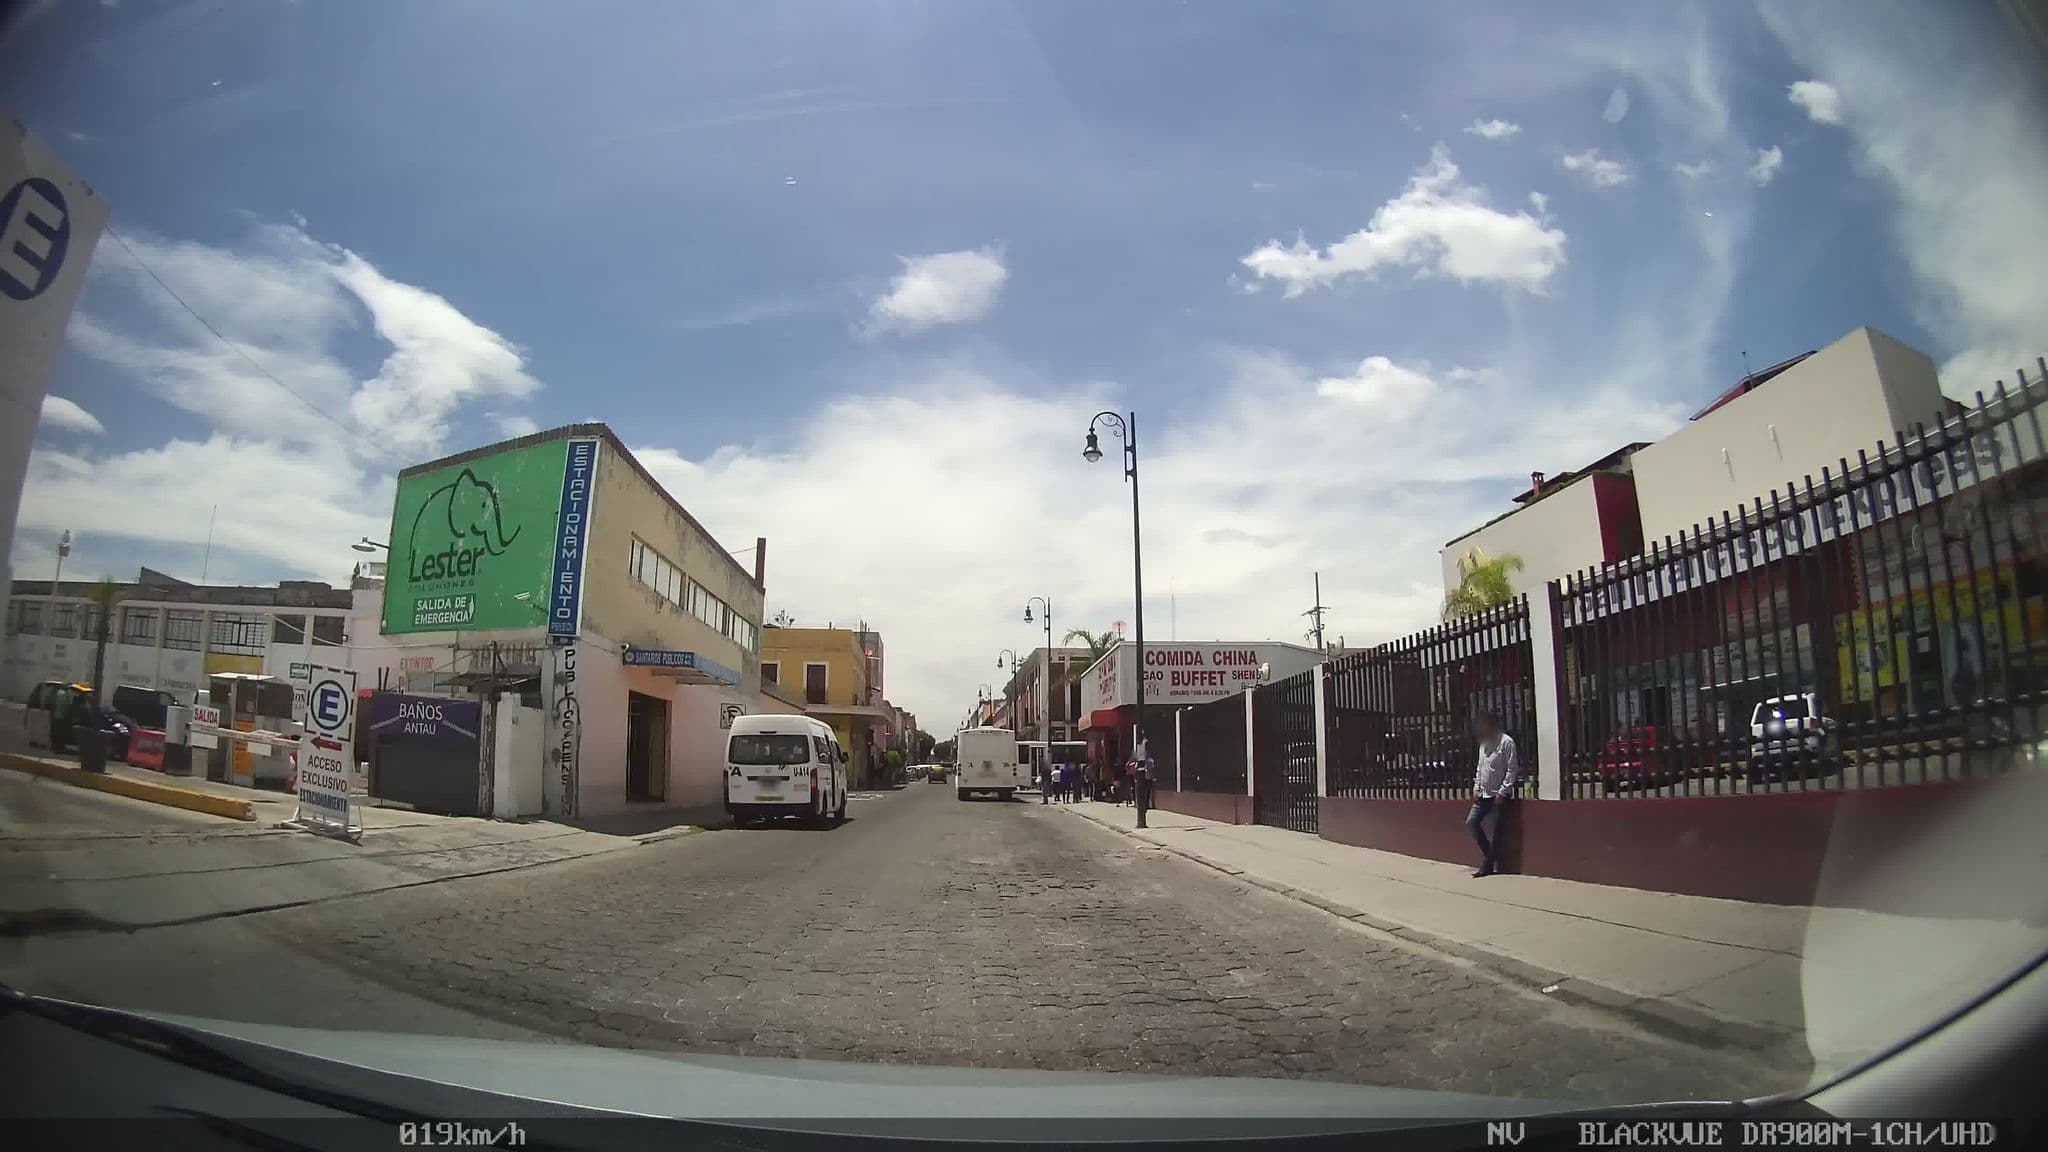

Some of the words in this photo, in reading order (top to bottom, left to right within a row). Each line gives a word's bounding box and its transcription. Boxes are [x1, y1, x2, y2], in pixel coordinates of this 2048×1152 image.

[556, 444, 590, 620] ESTACIONAMIENTO
[408, 541, 486, 583] Lester
[416, 598, 452, 612] SALIDA
[454, 596, 468, 609] DE
[414, 609, 470, 625] EMERGENCIA
[1145, 650, 1204, 667] COMIDA
[1212, 649, 1259, 667] CHINA
[1171, 670, 1227, 687] BUFFET
[318, 687, 341, 722] E
[399, 701, 443, 721] BAÑOS
[194, 708, 218, 725] SALIDA
[403, 722, 437, 735] ANTAU
[307, 755, 342, 773] ACCESO
[302, 770, 348, 793] EXCLUSIVO
